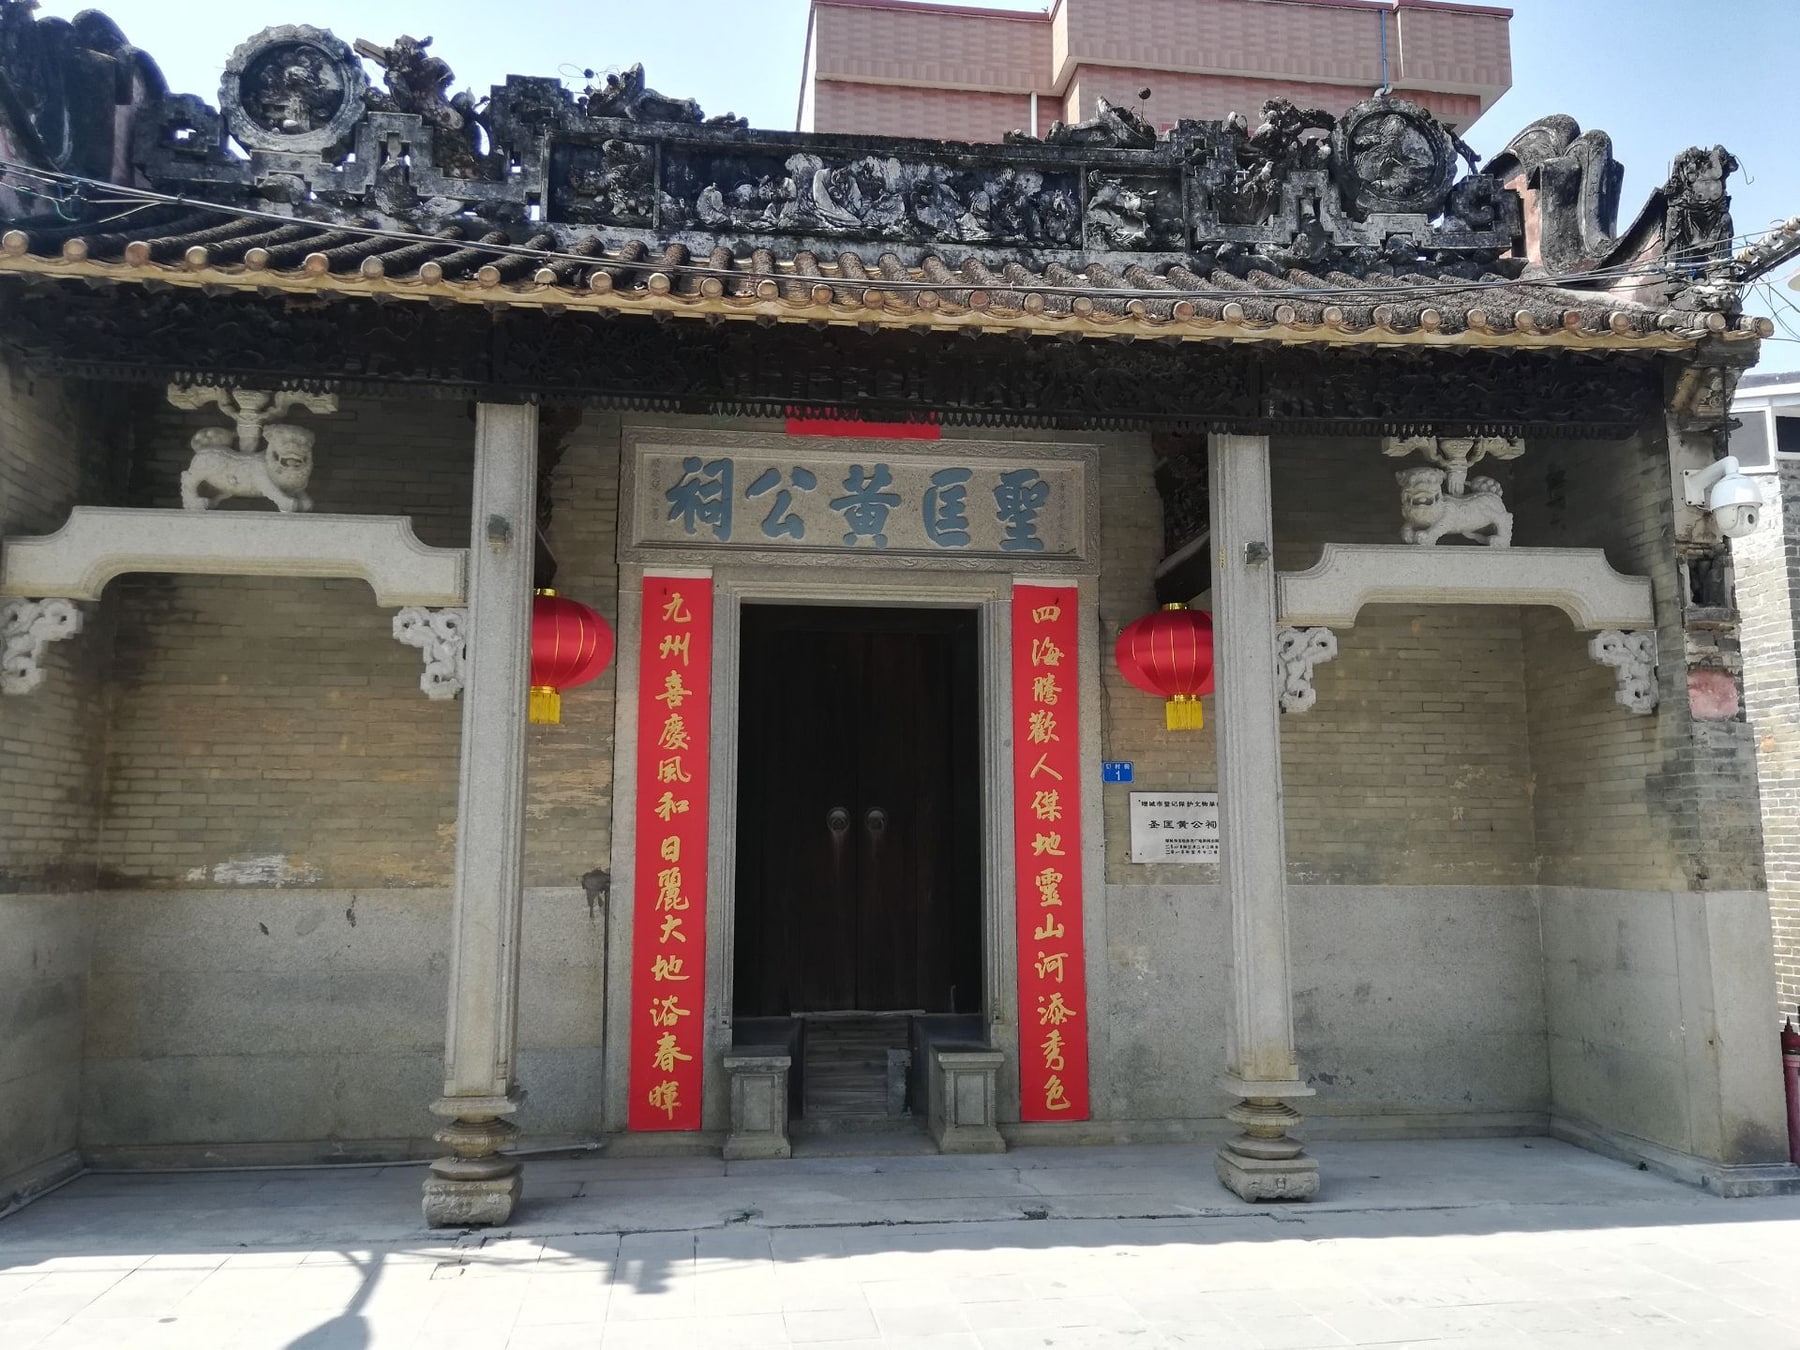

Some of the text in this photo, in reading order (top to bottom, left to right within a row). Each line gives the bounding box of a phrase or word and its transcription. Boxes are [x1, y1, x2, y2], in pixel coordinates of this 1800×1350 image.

[1027, 605, 1077, 1111] 四海騰歡人傑地靈山河添秀色
[1115, 770, 1121, 781] 1
